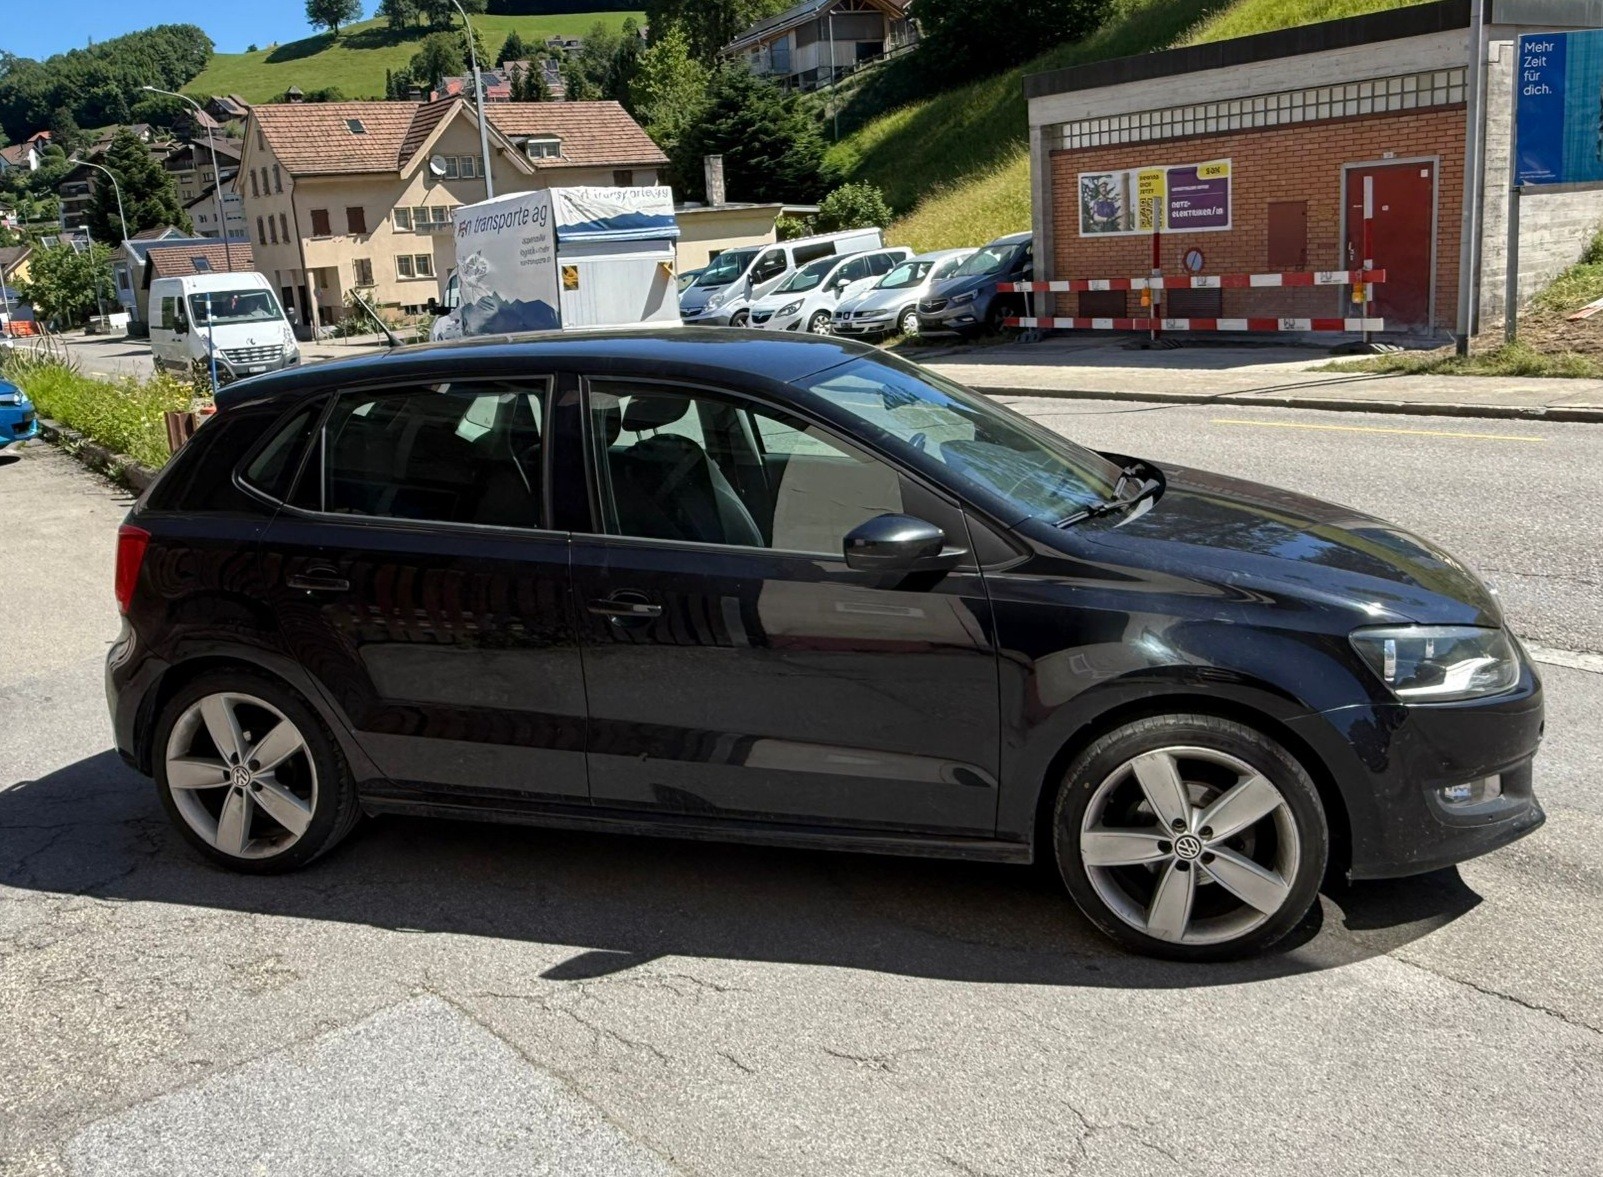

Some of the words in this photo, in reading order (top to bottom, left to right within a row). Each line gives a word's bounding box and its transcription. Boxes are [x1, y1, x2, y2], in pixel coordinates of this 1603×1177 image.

[1524, 41, 1555, 53] Mehr
[1523, 56, 1547, 68] Zeit
[1523, 70, 1541, 82] für
[1523, 83, 1553, 96] dich.
[474, 206, 530, 234] transporte
[531, 205, 547, 227] ag
